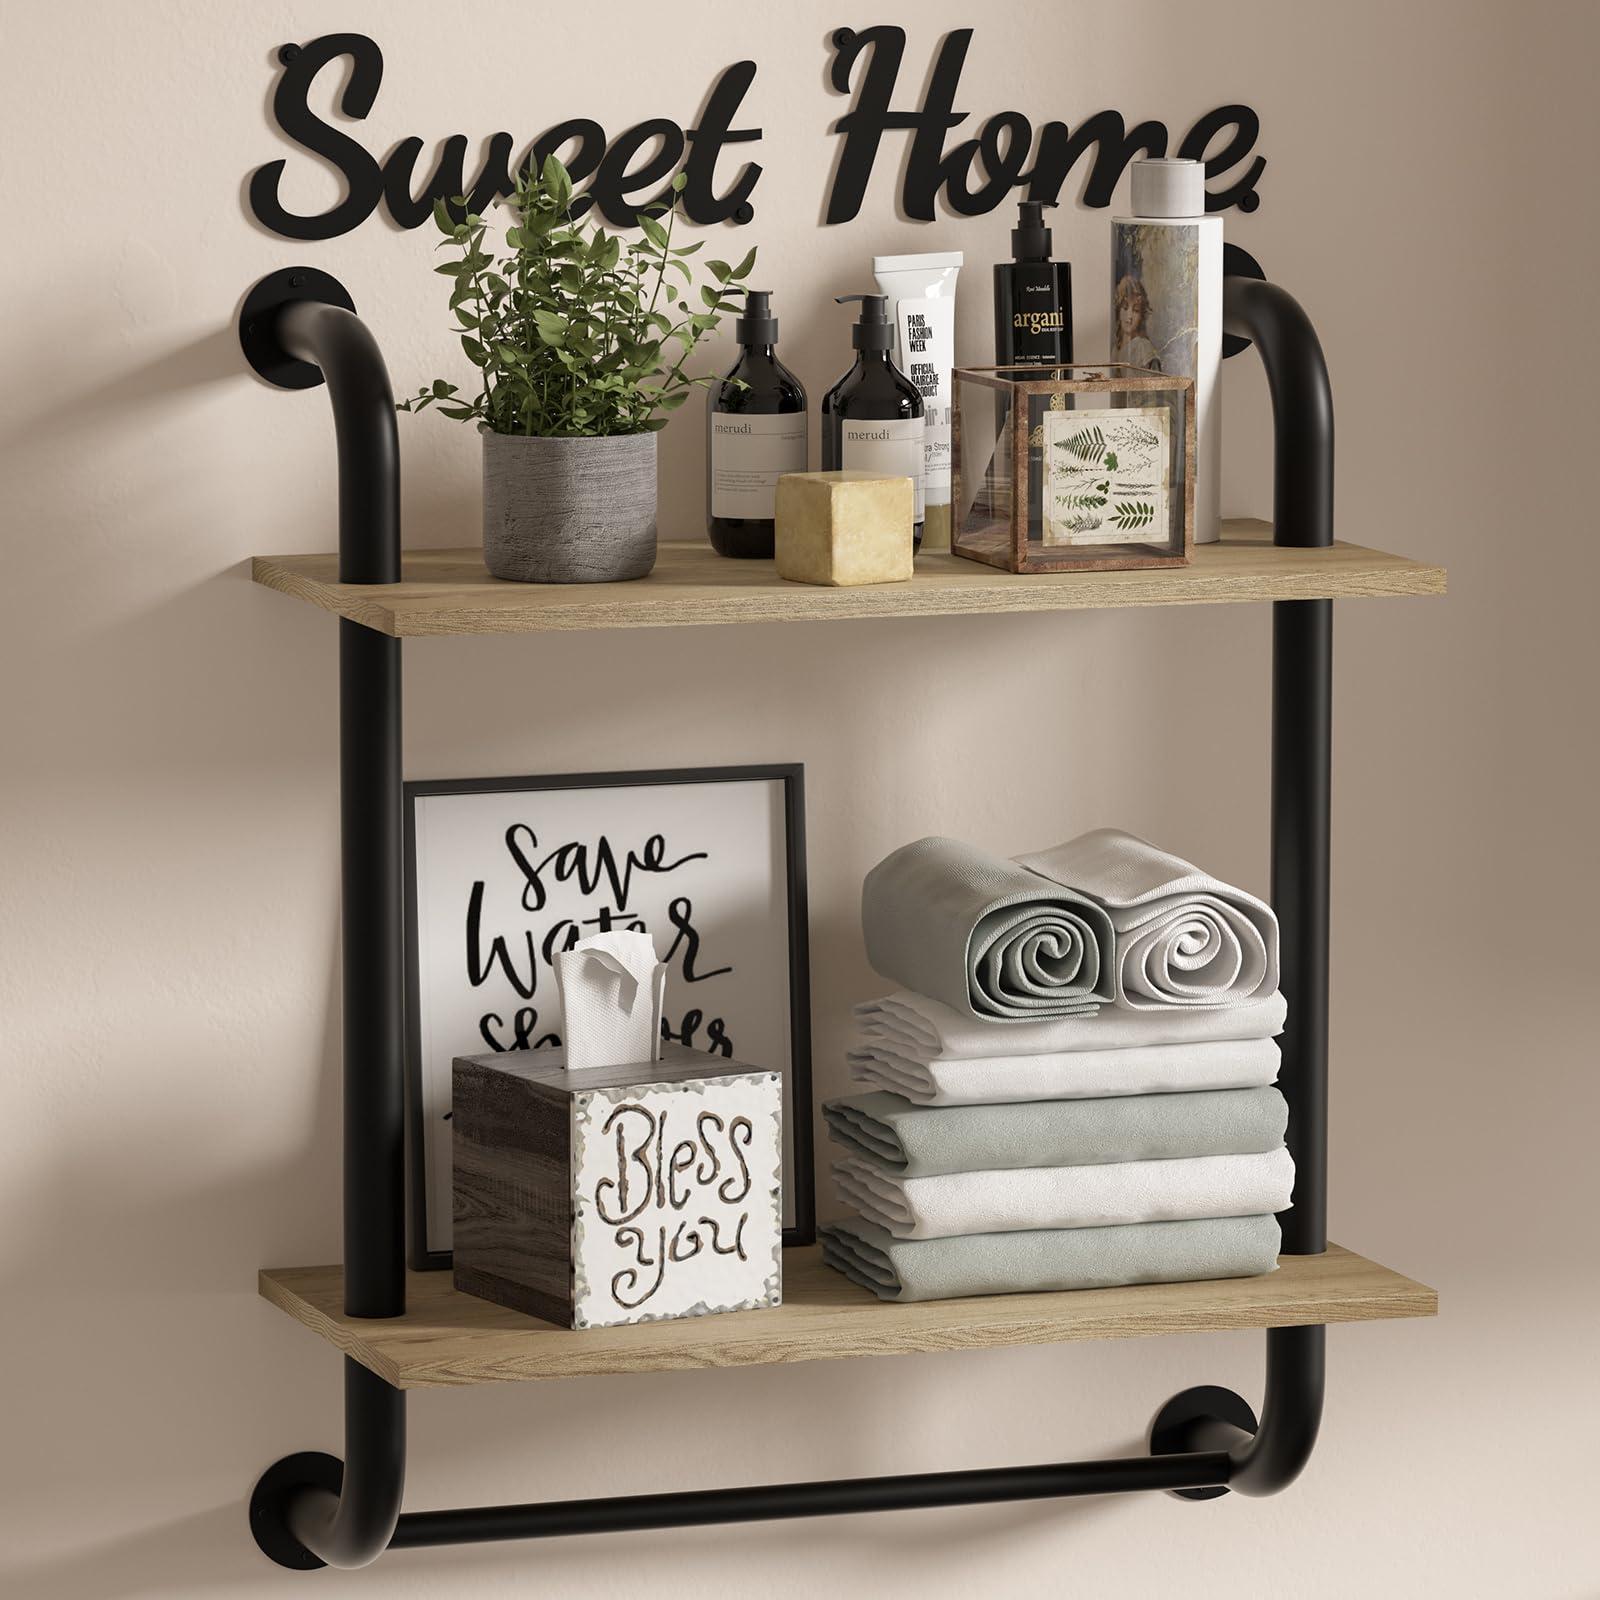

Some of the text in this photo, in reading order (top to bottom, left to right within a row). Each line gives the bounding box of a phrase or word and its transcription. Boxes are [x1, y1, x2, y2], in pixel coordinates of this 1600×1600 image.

[249, 25, 1267, 240] Sweet Home
[907, 314, 926, 327] PARIS
[1013, 306, 1064, 334] argani
[908, 327, 933, 340] FASHION
[909, 340, 927, 352] WEEK
[910, 363, 935, 375] OFFICIAL
[714, 423, 752, 434] merudi
[847, 429, 890, 440] merudi
[505, 823, 708, 912] Save
[595, 1103, 753, 1226] Bless
